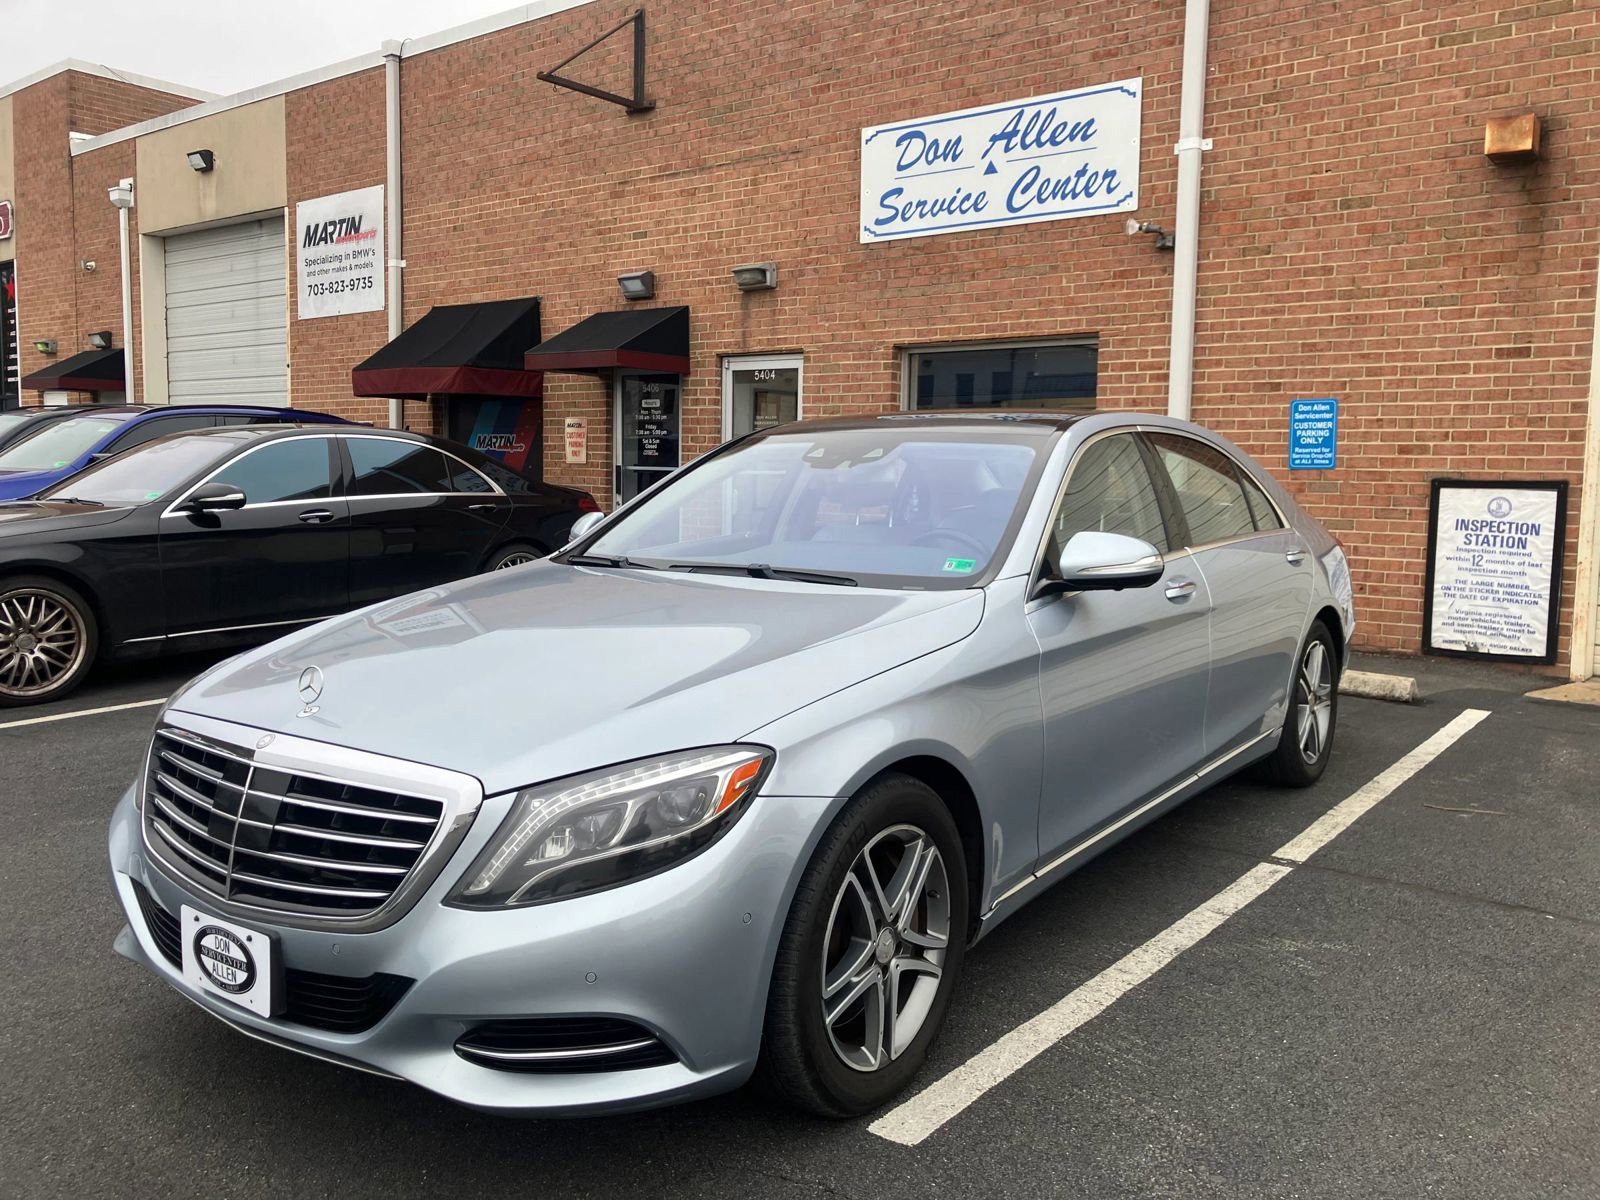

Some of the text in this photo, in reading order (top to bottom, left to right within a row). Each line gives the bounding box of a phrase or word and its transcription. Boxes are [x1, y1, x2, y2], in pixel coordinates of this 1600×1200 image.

[895, 106, 1098, 172] Don Allen
[874, 162, 1121, 226] Service Center
[303, 215, 363, 249] MARTIN
[304, 248, 376, 268] Specializing in BMW's
[306, 269, 316, 278] and
[317, 267, 331, 276] other
[331, 264, 348, 273] makes
[353, 261, 374, 270] models
[307, 276, 373, 297] 703-823-9735
[754, 370, 776, 380] 5404
[476, 434, 516, 449] MARTIN
[1455, 518, 1541, 536] INSPECTION
[1463, 533, 1528, 550] STATION
[1456, 546, 1532, 558] Inspection required
[1471, 554, 1484, 567] 12
[1458, 566, 1527, 577] inspection month
[1469, 587, 1500, 595] STICKER
[1502, 590, 1543, 599] INDICATES
[1497, 582, 1530, 590] NUMBER
[1492, 596, 1539, 606] EXPIRATION
[1455, 609, 1482, 617] Virginia
[214, 936, 230, 954] DON
[201, 946, 247, 971] SERVICENTER
[212, 961, 237, 984] ALLEN
